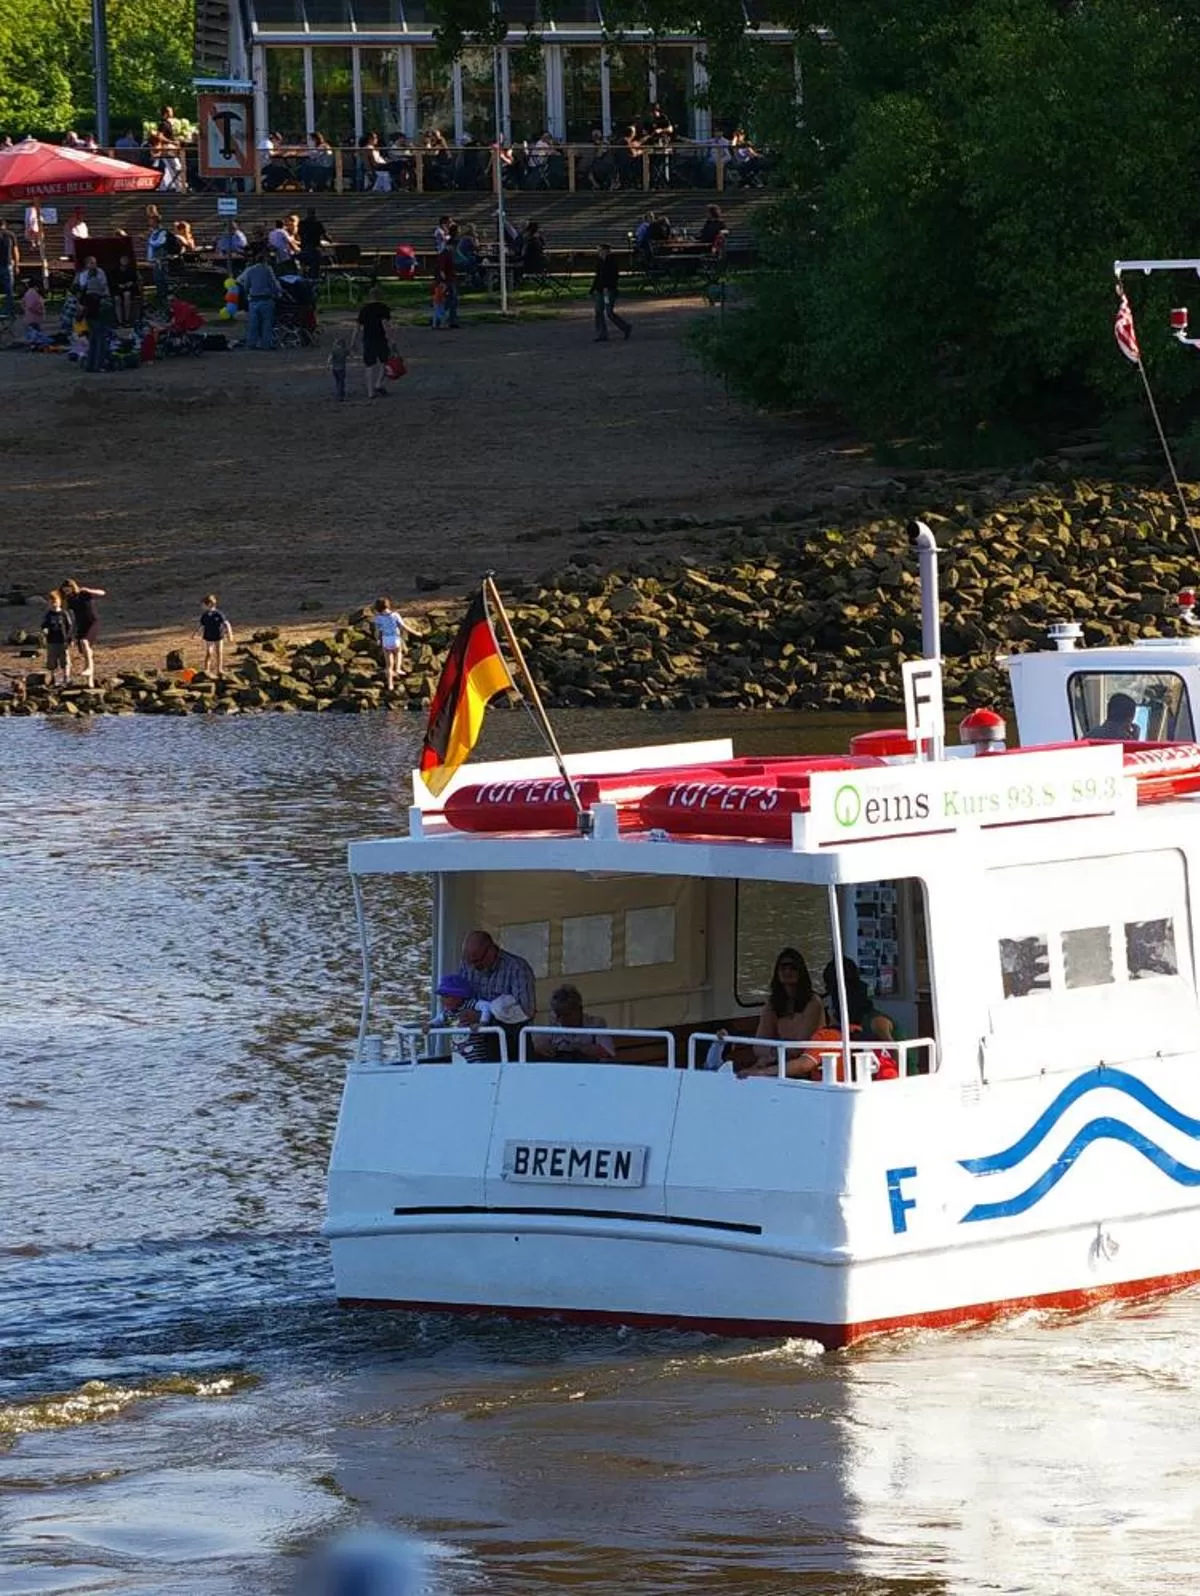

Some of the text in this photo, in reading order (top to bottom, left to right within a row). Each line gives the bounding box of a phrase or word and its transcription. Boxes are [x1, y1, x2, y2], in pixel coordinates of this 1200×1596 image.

[912, 670, 932, 727] F
[865, 791, 931, 825] eins
[943, 790, 1000, 817] Kurs
[513, 1145, 632, 1181] BREMEN
[886, 1166, 918, 1234] F
